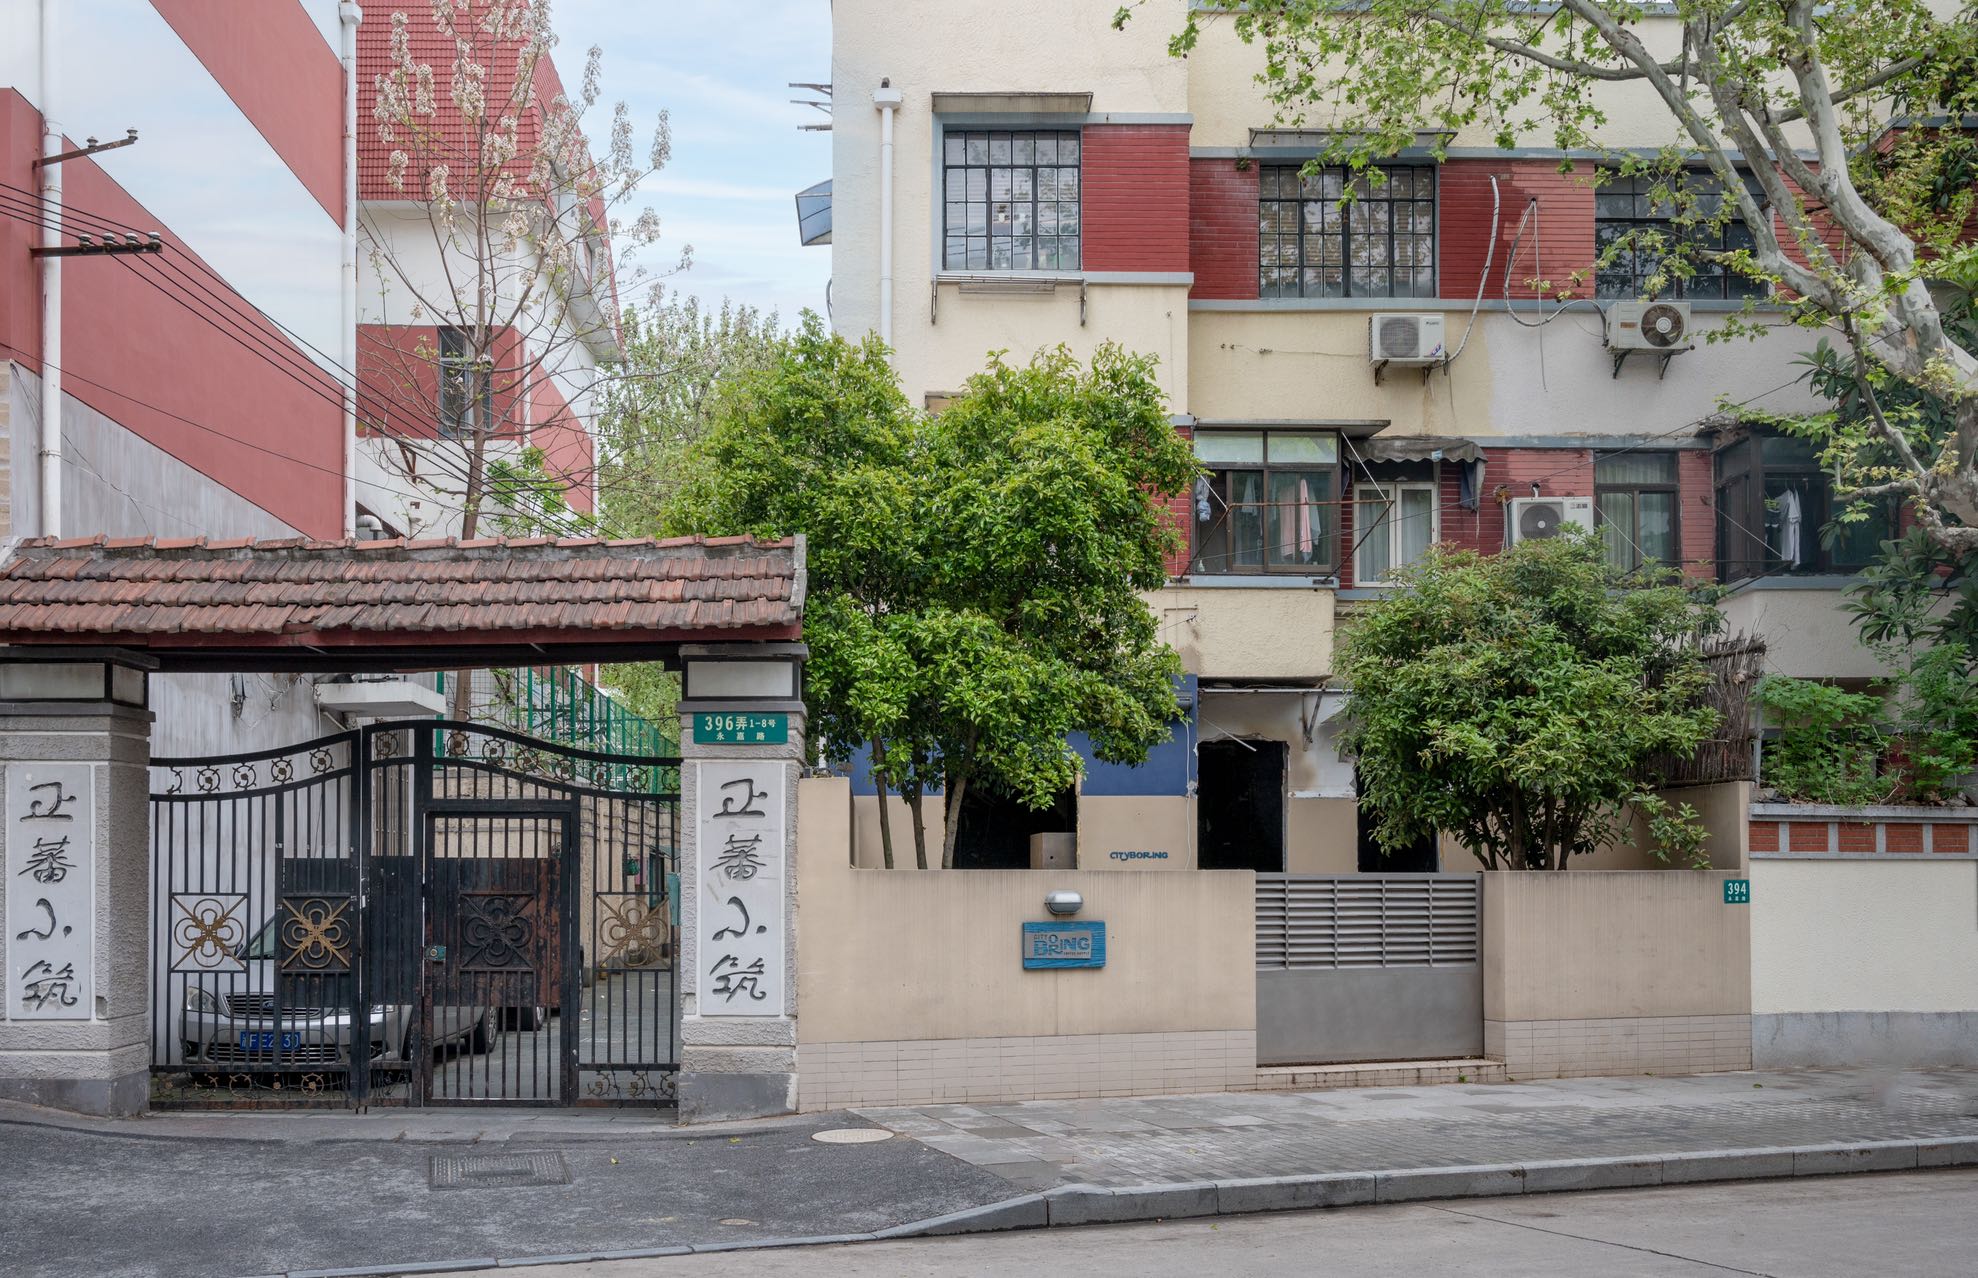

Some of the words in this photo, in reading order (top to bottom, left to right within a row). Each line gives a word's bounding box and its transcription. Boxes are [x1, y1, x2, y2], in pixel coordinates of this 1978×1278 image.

[1727, 882, 1746, 895] 394
[1033, 934, 1090, 956] BORING
[241, 1034, 299, 1047] FE23
